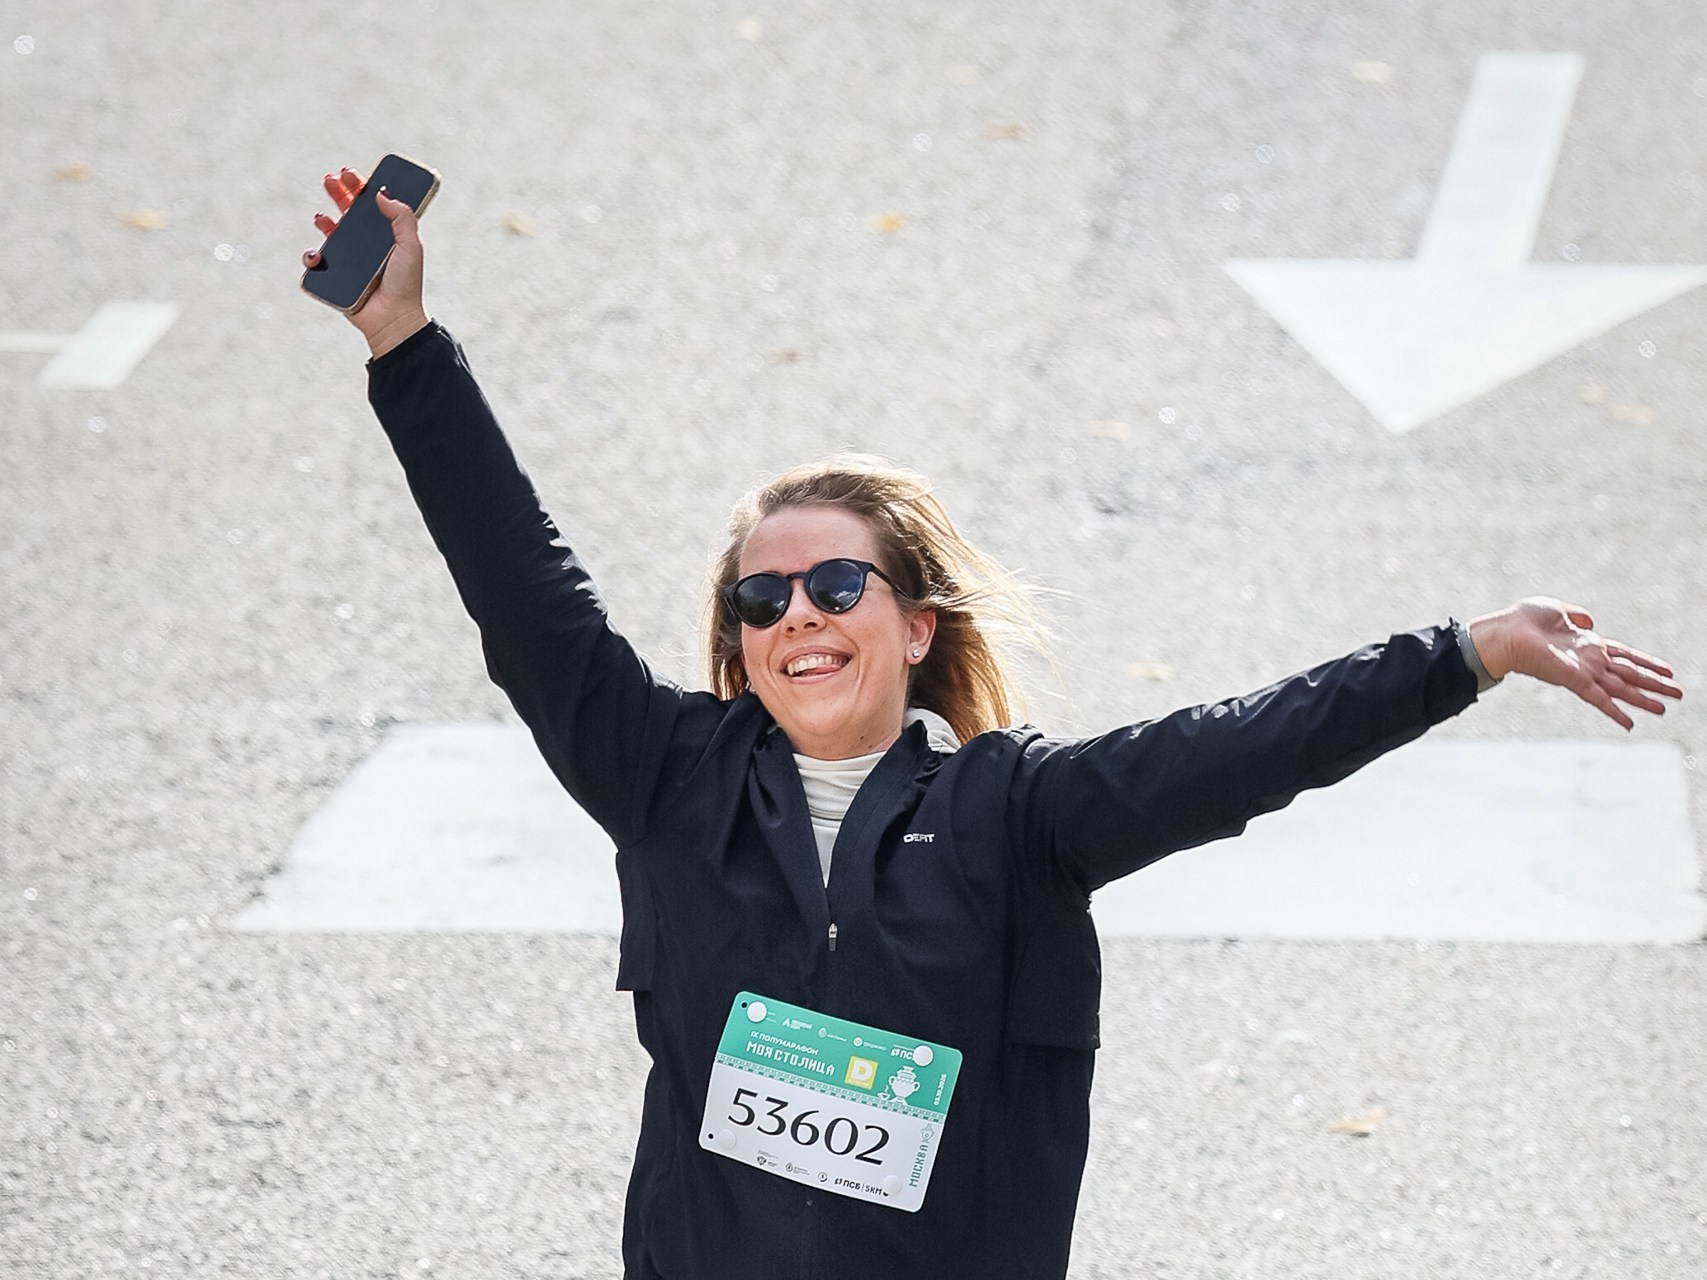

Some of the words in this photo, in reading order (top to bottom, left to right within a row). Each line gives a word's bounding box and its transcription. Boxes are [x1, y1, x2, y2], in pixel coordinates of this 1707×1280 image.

[746, 1041, 773, 1058] МОЯ
[774, 1049, 835, 1076] СТОЛИЦА
[759, 1033, 819, 1055] ПОЛУМАРАФОН
[850, 1058, 873, 1082] D
[728, 1088, 890, 1165] 53602
[909, 1144, 929, 1188] МОСКВА
[843, 1179, 861, 1190] ПСБ
